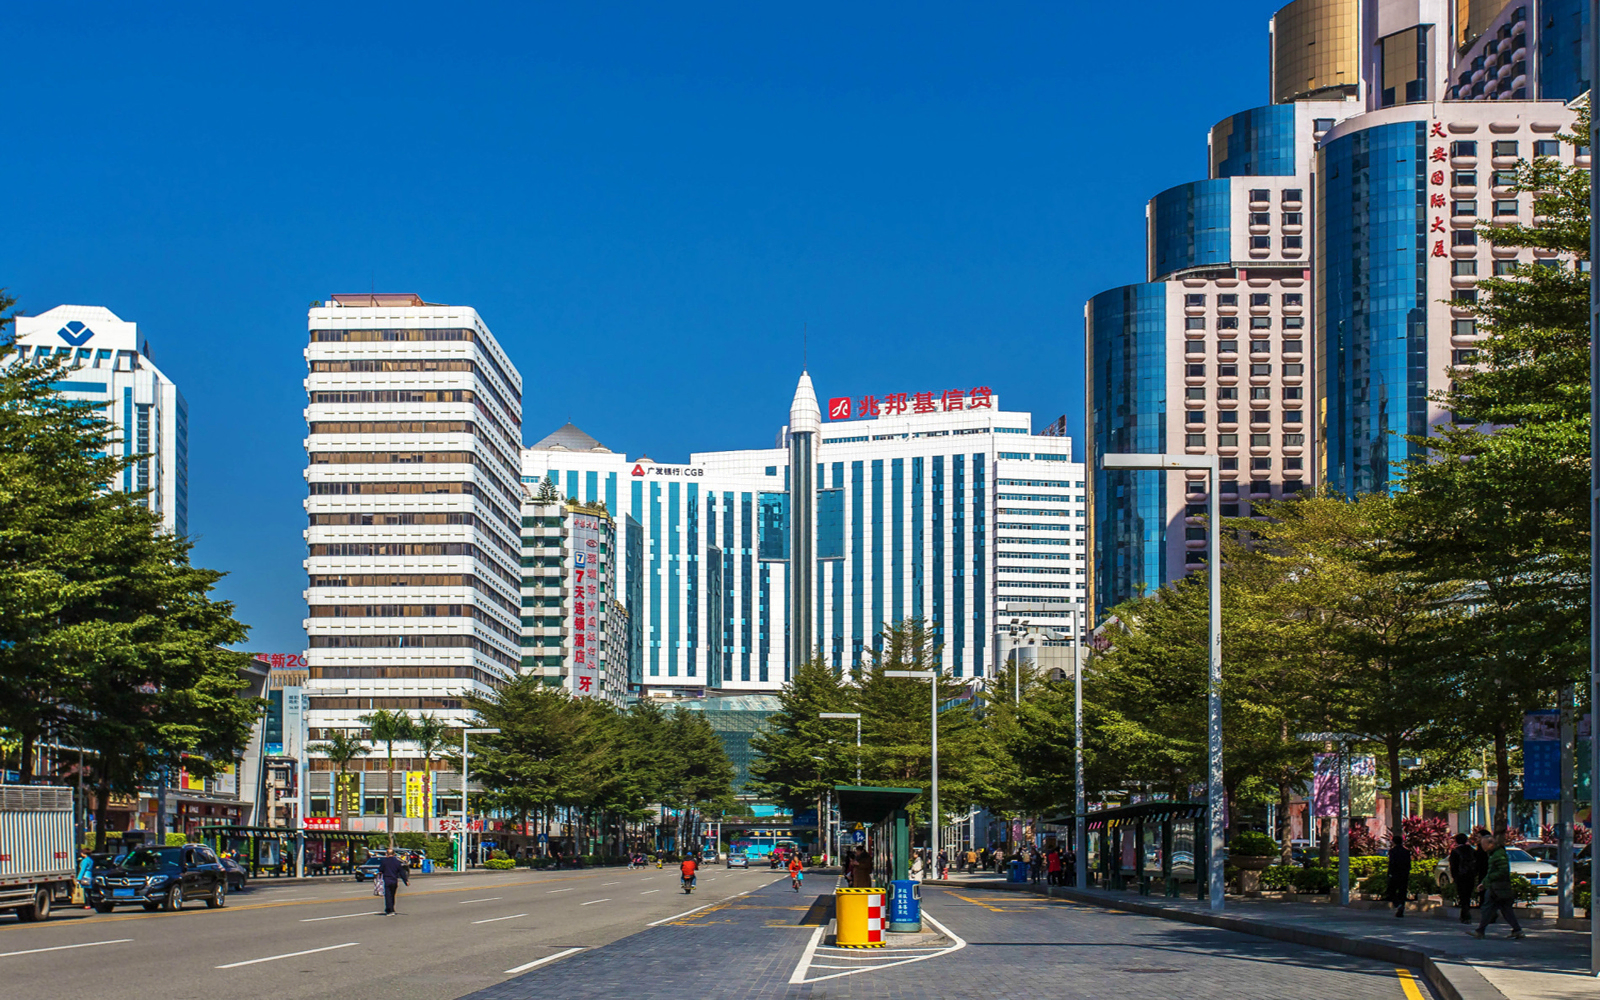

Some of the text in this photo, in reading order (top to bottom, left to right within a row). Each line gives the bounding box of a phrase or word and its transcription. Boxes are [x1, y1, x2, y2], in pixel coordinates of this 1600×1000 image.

[859, 386, 992, 418] 兆邦基信贷
[647, 467, 704, 477] 广发银行 CGB
[574, 570, 585, 664] 7天连锁酒店
[579, 676, 592, 692] 牙
